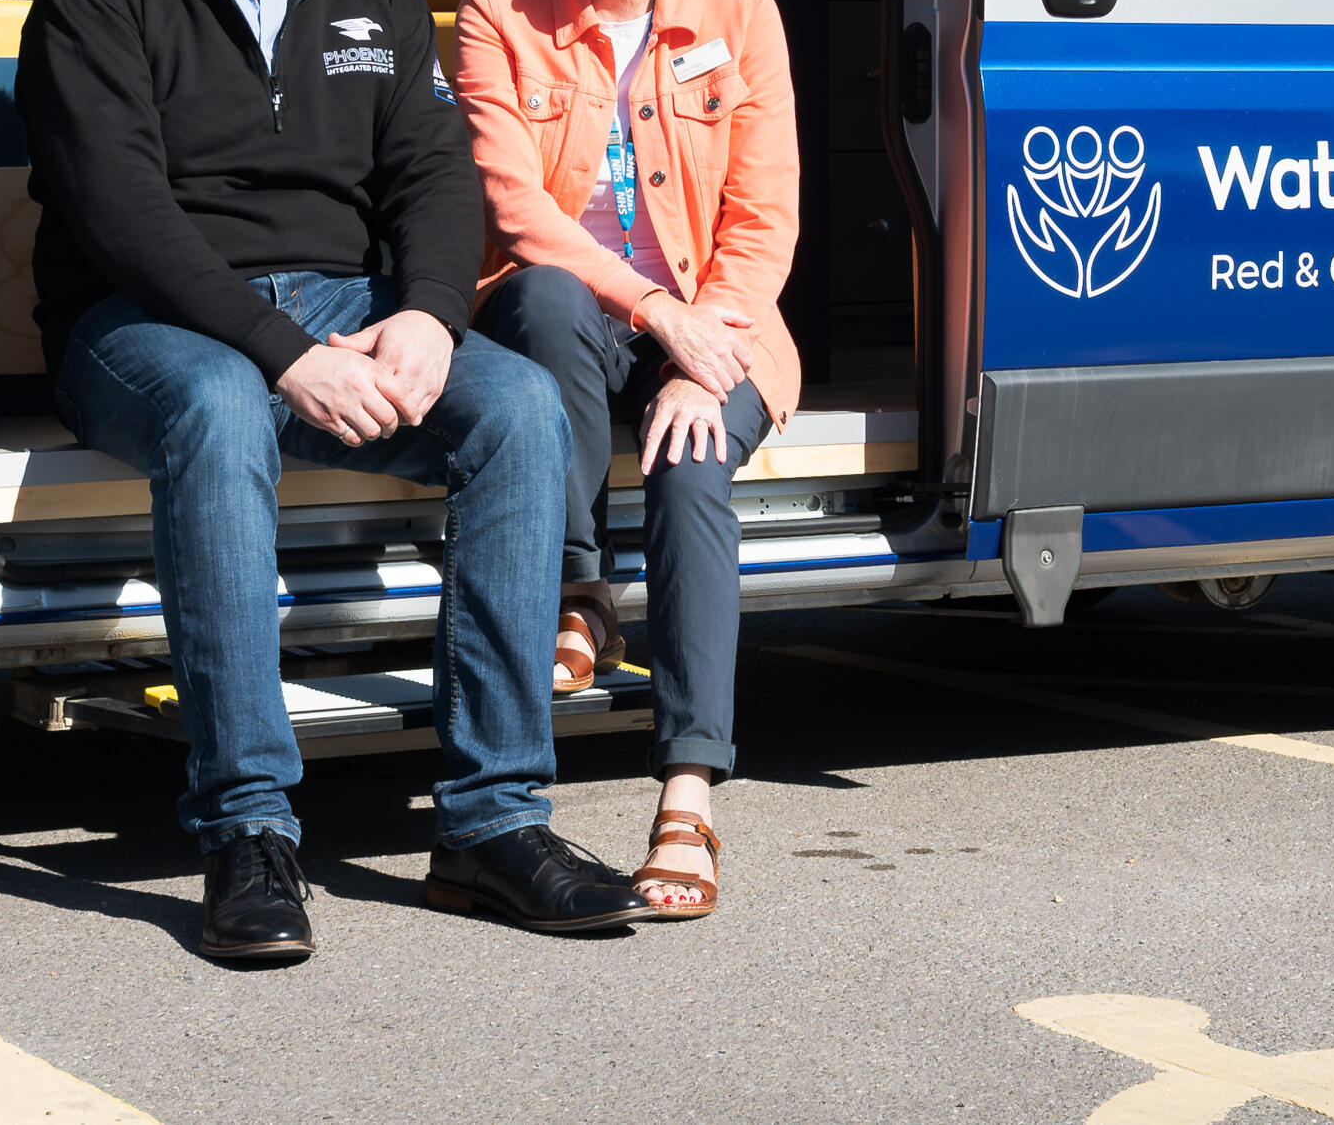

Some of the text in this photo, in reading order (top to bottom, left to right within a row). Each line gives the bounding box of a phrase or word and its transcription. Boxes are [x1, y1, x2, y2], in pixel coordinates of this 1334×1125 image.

[323, 47, 388, 65] PHOENIX
[327, 64, 372, 75] INTEGRATED
[611, 158, 624, 183] NHS
[615, 191, 628, 215] NHS
[1212, 251, 1283, 289] Red
[1296, 253, 1318, 287] &
